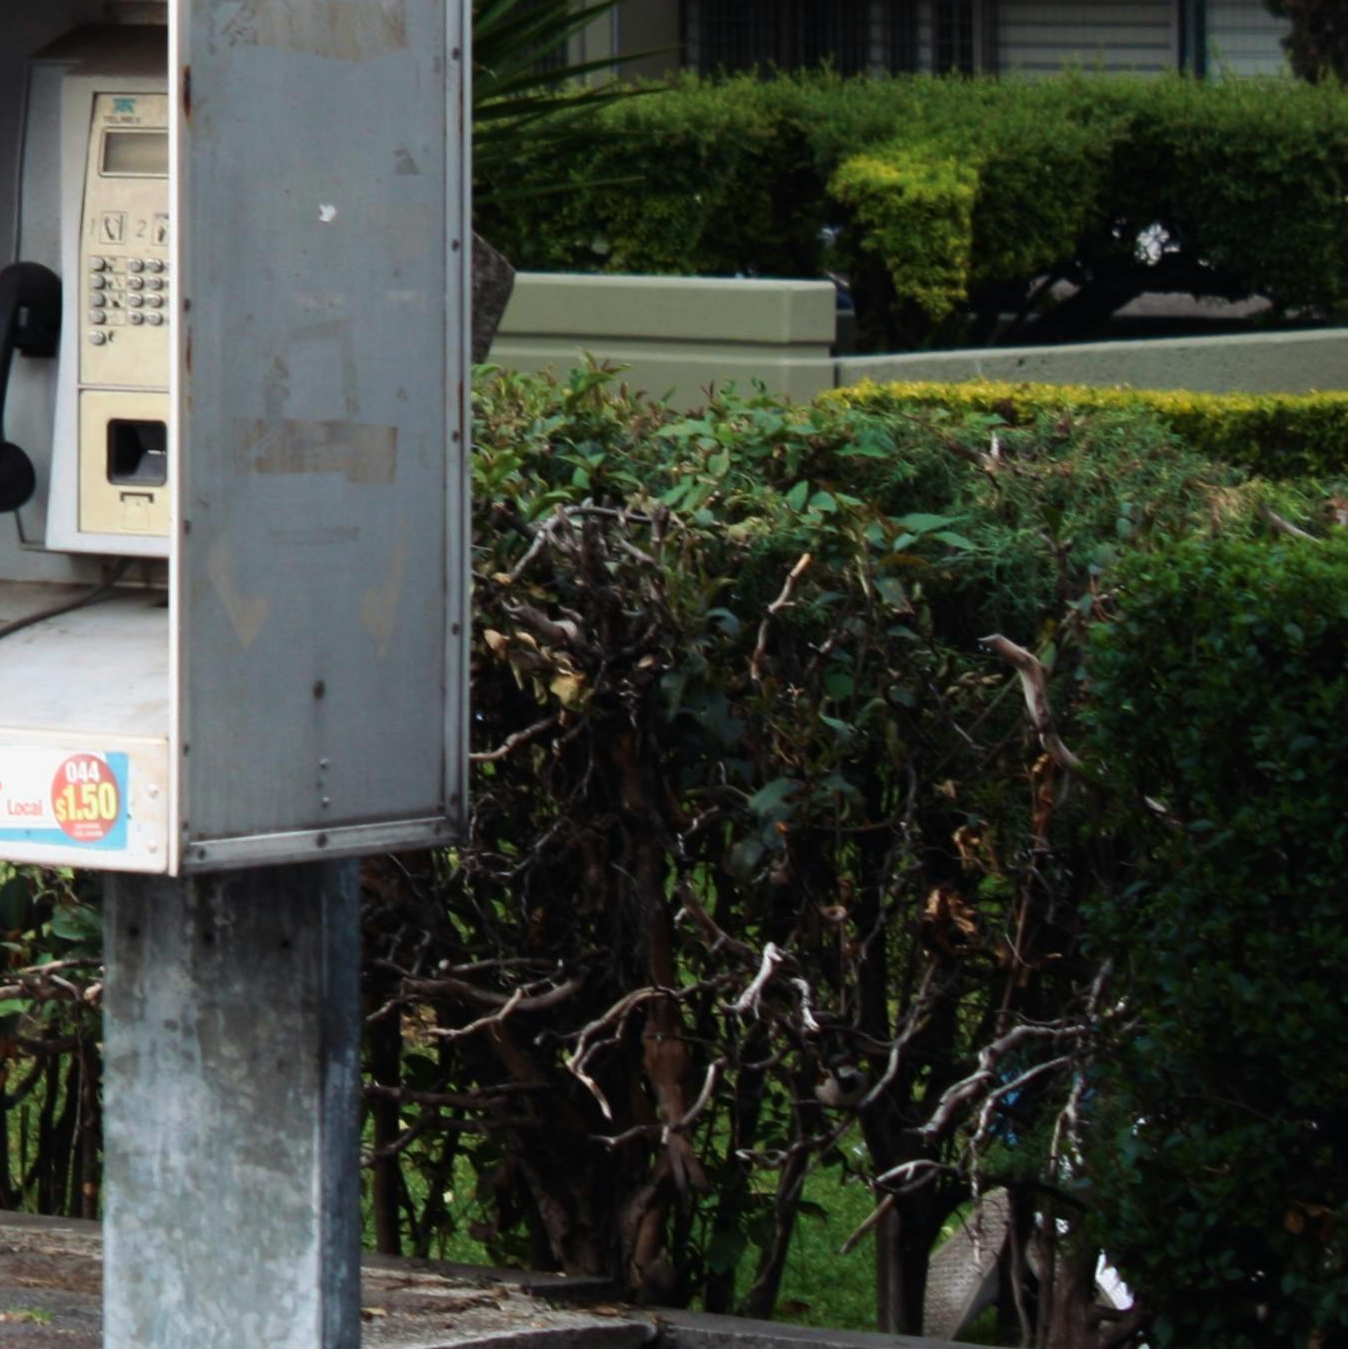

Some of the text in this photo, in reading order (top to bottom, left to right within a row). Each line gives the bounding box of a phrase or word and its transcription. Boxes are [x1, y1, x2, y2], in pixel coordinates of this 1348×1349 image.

[65, 761, 100, 783] 044
[7, 798, 43, 816] Local
[55, 782, 117, 822] $1.50
